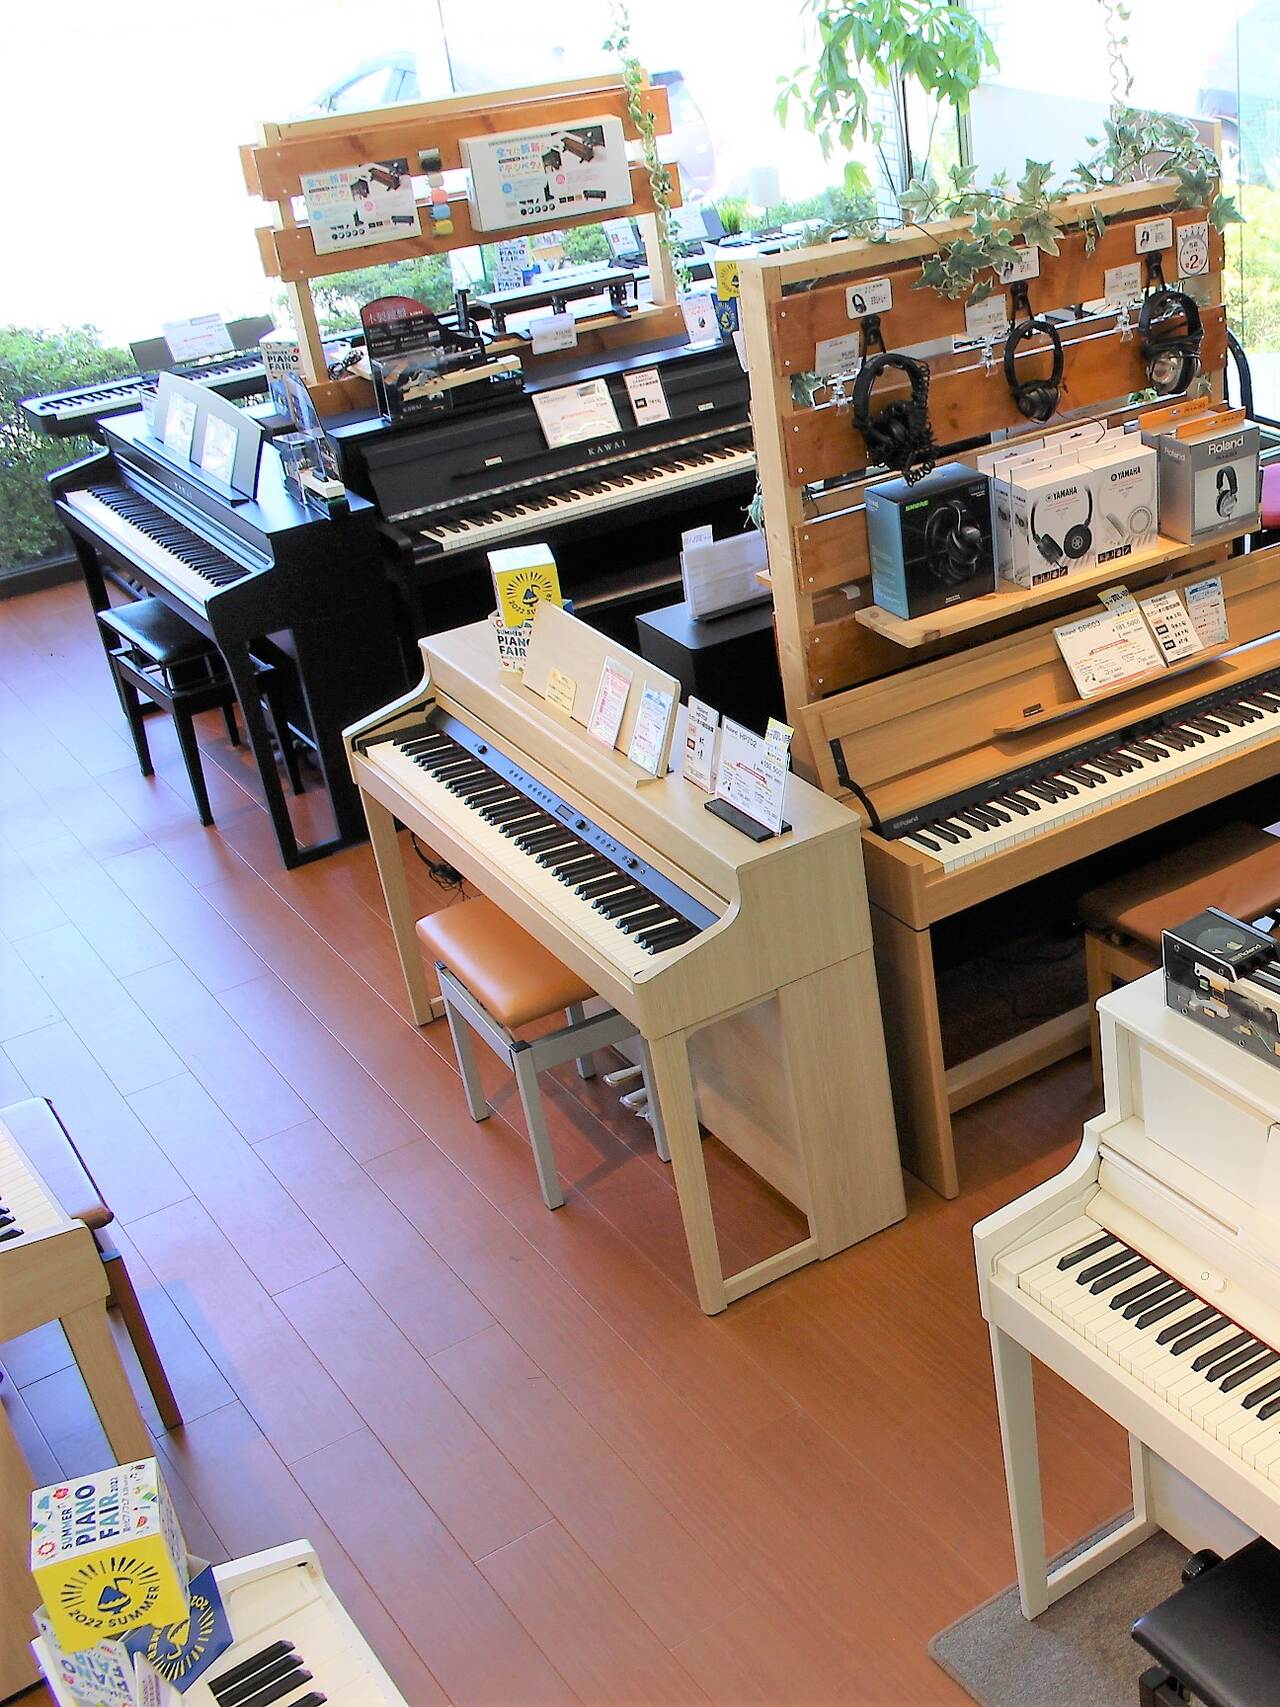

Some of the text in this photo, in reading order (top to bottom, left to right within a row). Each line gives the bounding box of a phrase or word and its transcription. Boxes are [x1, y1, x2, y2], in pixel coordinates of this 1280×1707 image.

[267, 355, 299, 363] PIANO
[587, 439, 626, 456] KAWAI
[1208, 435, 1244, 456] Roland
[1164, 446, 1185, 461] Roland
[1117, 466, 1142, 480] YAMAHA
[1052, 486, 1078, 500] YAMAHA
[509, 600, 525, 614] 2022
[496, 628, 522, 637] SUMMER
[1077, 619, 1101, 633] DP603
[500, 645, 527, 657] FAIR
[739, 732, 758, 749] HP702
[1239, 943, 1262, 957] Roland
[75, 1484, 97, 1547] PIANO
[98, 1476, 121, 1541] FAIR 2022
[61, 1507, 73, 1550] SUMMER
[68, 1585, 161, 1629] 2022 SUMMER
